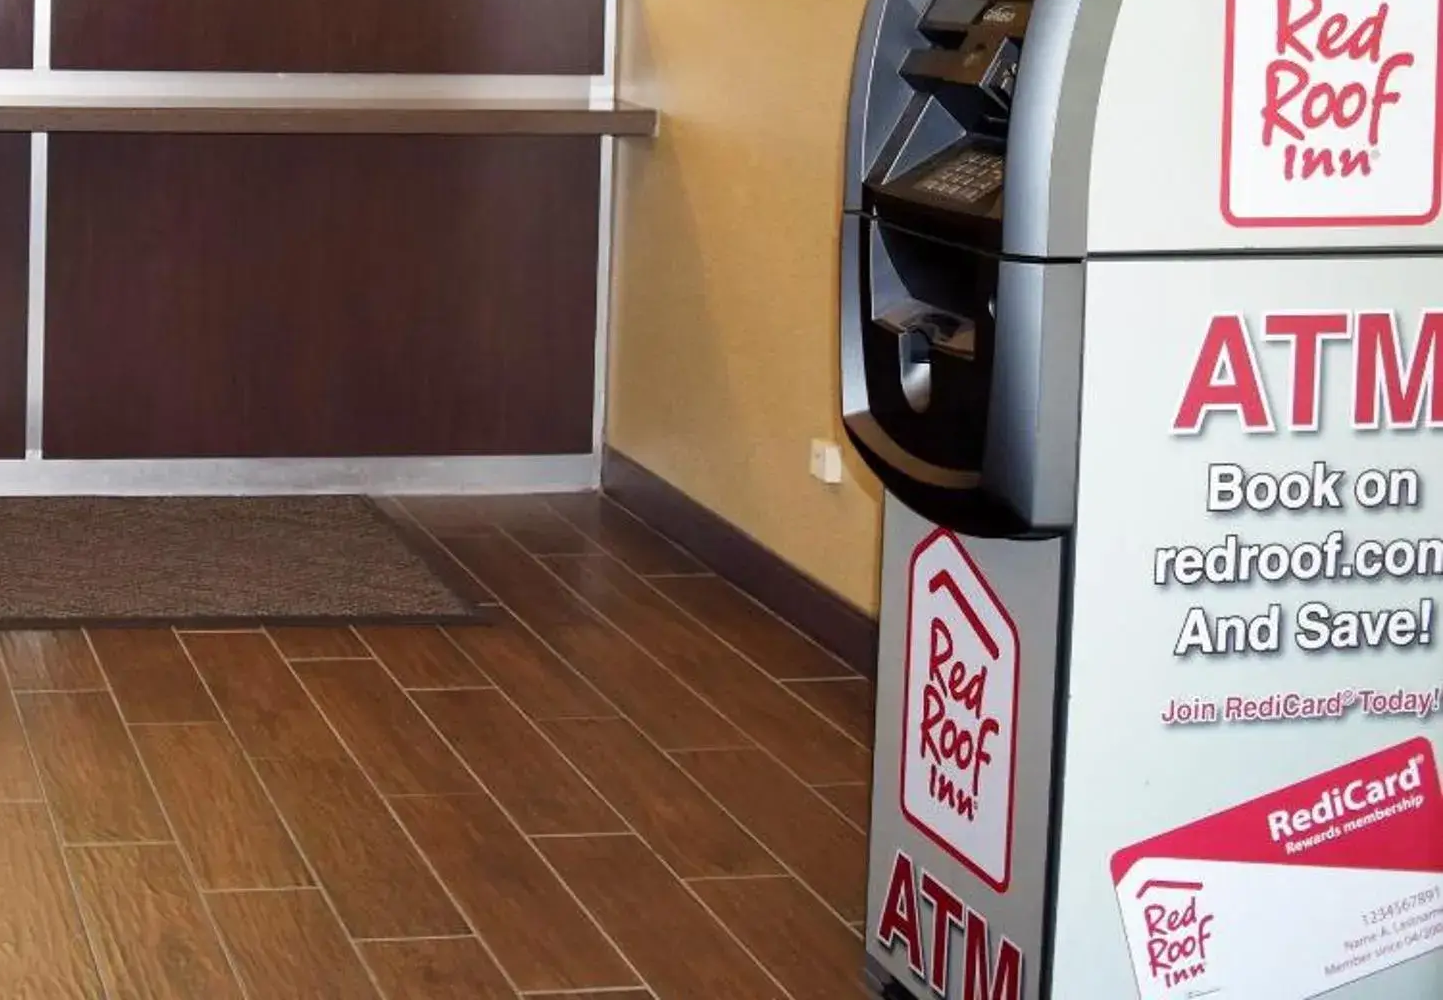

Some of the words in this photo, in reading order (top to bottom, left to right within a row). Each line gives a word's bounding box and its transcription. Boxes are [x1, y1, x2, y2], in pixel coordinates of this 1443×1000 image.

[1261, 51, 1415, 147] Roof
[1169, 308, 1443, 434] ATM
[1207, 461, 1346, 512] Book
[1354, 468, 1419, 508] on
[1174, 603, 1282, 656] And
[1295, 597, 1435, 651] Save!
[929, 617, 988, 719] Red
[1161, 698, 1216, 724] Join
[1359, 687, 1441, 716] Today!
[921, 684, 999, 796] Roof
[1285, 825, 1342, 855] Rewards
[1343, 795, 1425, 834] membership
[877, 849, 1022, 1000] ATM
[1144, 896, 1198, 938] Red
[1148, 914, 1214, 977] Roof
[1323, 951, 1372, 976] Member
